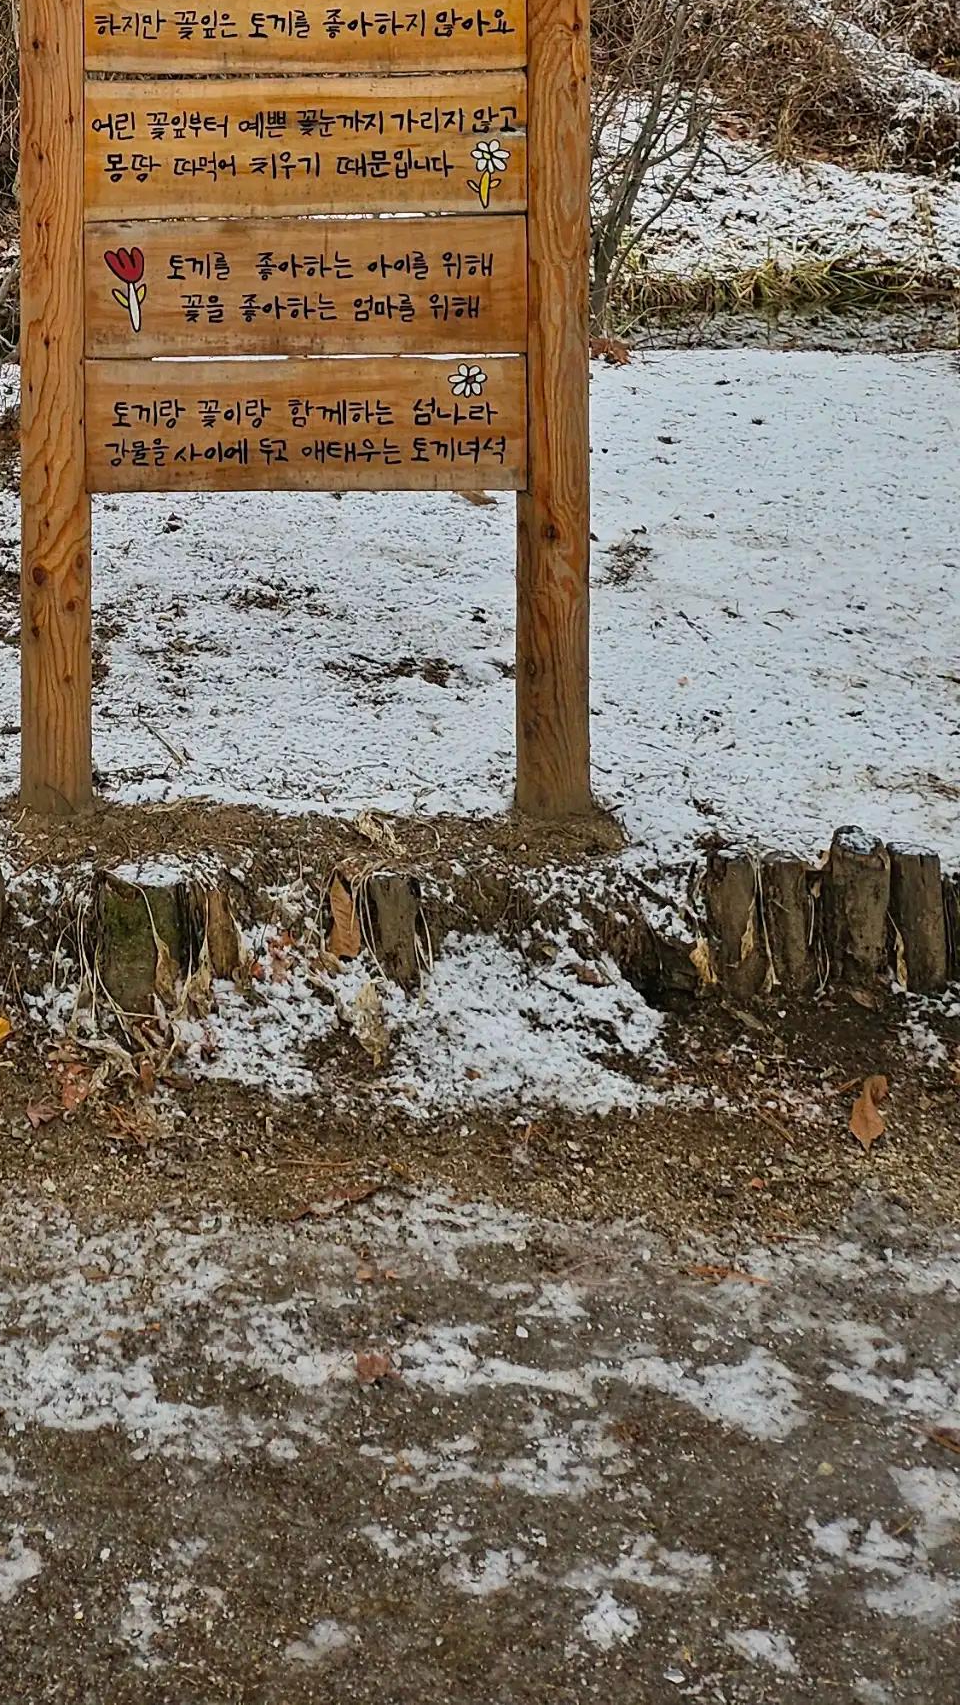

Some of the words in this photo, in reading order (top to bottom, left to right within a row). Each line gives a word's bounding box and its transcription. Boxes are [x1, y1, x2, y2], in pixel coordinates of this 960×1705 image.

[94, 9, 166, 39] 하지만
[174, 10, 238, 39] 꽃잎은
[248, 10, 310, 39] 토끼를
[323, 9, 425, 39] 좋아하지
[434, 8, 515, 37] 않아요
[92, 111, 136, 140] 어린
[146, 111, 229, 141] 꽃잎부터
[239, 111, 287, 139] 예쁜
[296, 108, 383, 136] 꽃눈까지
[472, 106, 517, 133] 않고
[104, 153, 161, 183] 몽땅
[173, 151, 237, 182] 따먹어
[249, 151, 320, 179] 치우기
[336, 148, 454, 178] 때문입니다
[167, 252, 230, 281] 토끼를
[256, 251, 353, 281] 좋아하는
[367, 251, 429, 280] 아이를
[442, 251, 494, 279] 위해
[181, 294, 224, 323] 꽃을
[239, 294, 337, 322] 좋아하는
[353, 294, 415, 322] 엄마를
[429, 294, 480, 321] 위해
[112, 399, 186, 429] 토끼랑
[198, 399, 272, 428] 꽃이랑
[288, 399, 394, 427] 함께하는
[413, 397, 498, 426] 섬나라
[105, 438, 170, 467] 강물을
[174, 438, 248, 464] 사이에
[259, 438, 289, 465] 두고
[301, 438, 402, 464] 애태우는
